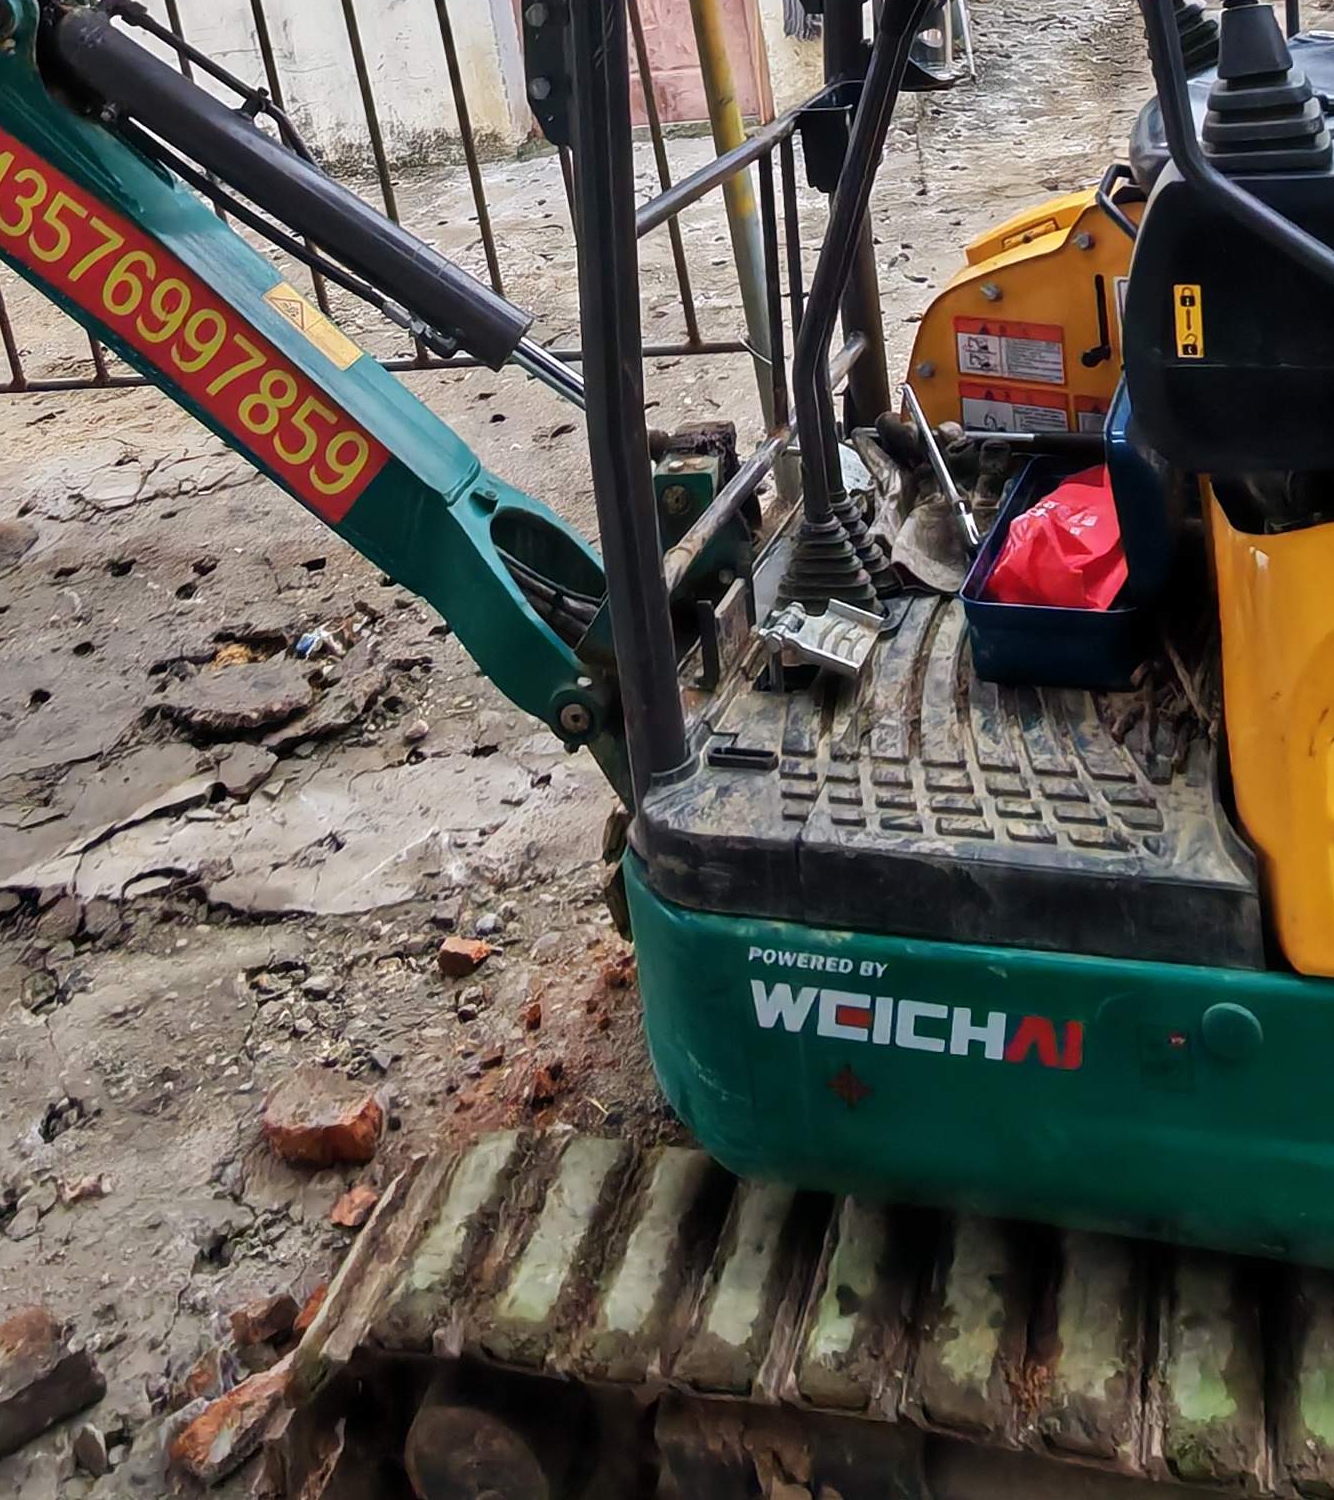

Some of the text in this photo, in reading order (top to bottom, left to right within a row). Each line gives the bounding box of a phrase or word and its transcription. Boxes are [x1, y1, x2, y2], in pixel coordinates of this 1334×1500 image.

[748, 946, 889, 979] POWERED BY
[750, 979, 1084, 1071] WEICHAI
